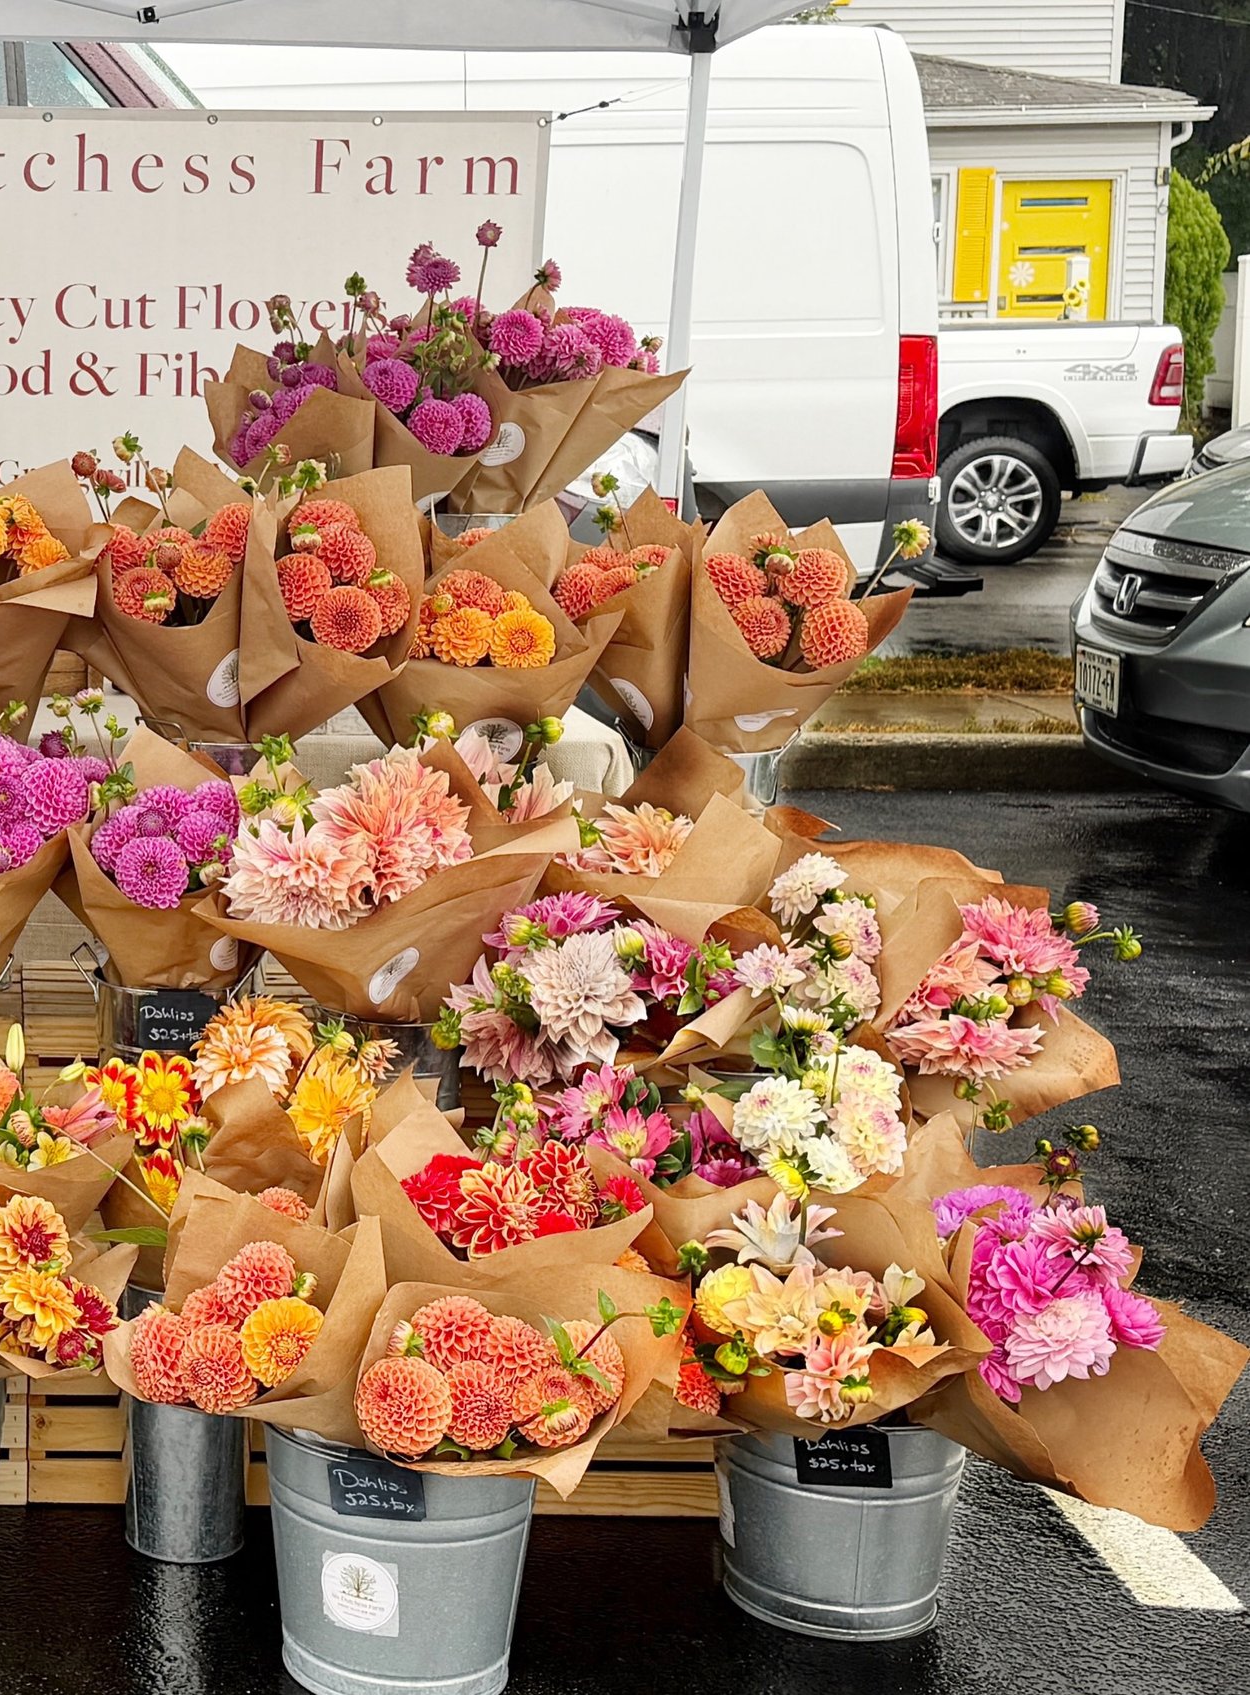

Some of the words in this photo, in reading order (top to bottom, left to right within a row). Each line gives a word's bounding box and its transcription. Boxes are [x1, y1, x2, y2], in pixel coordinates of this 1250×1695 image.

[307, 138, 523, 196] Farm
[54, 283, 156, 330] Cut
[68, 351, 119, 397] &
[134, 350, 231, 398] Fib
[139, 1005, 195, 1022] Dahlias
[332, 1469, 408, 1495] Dahlias
